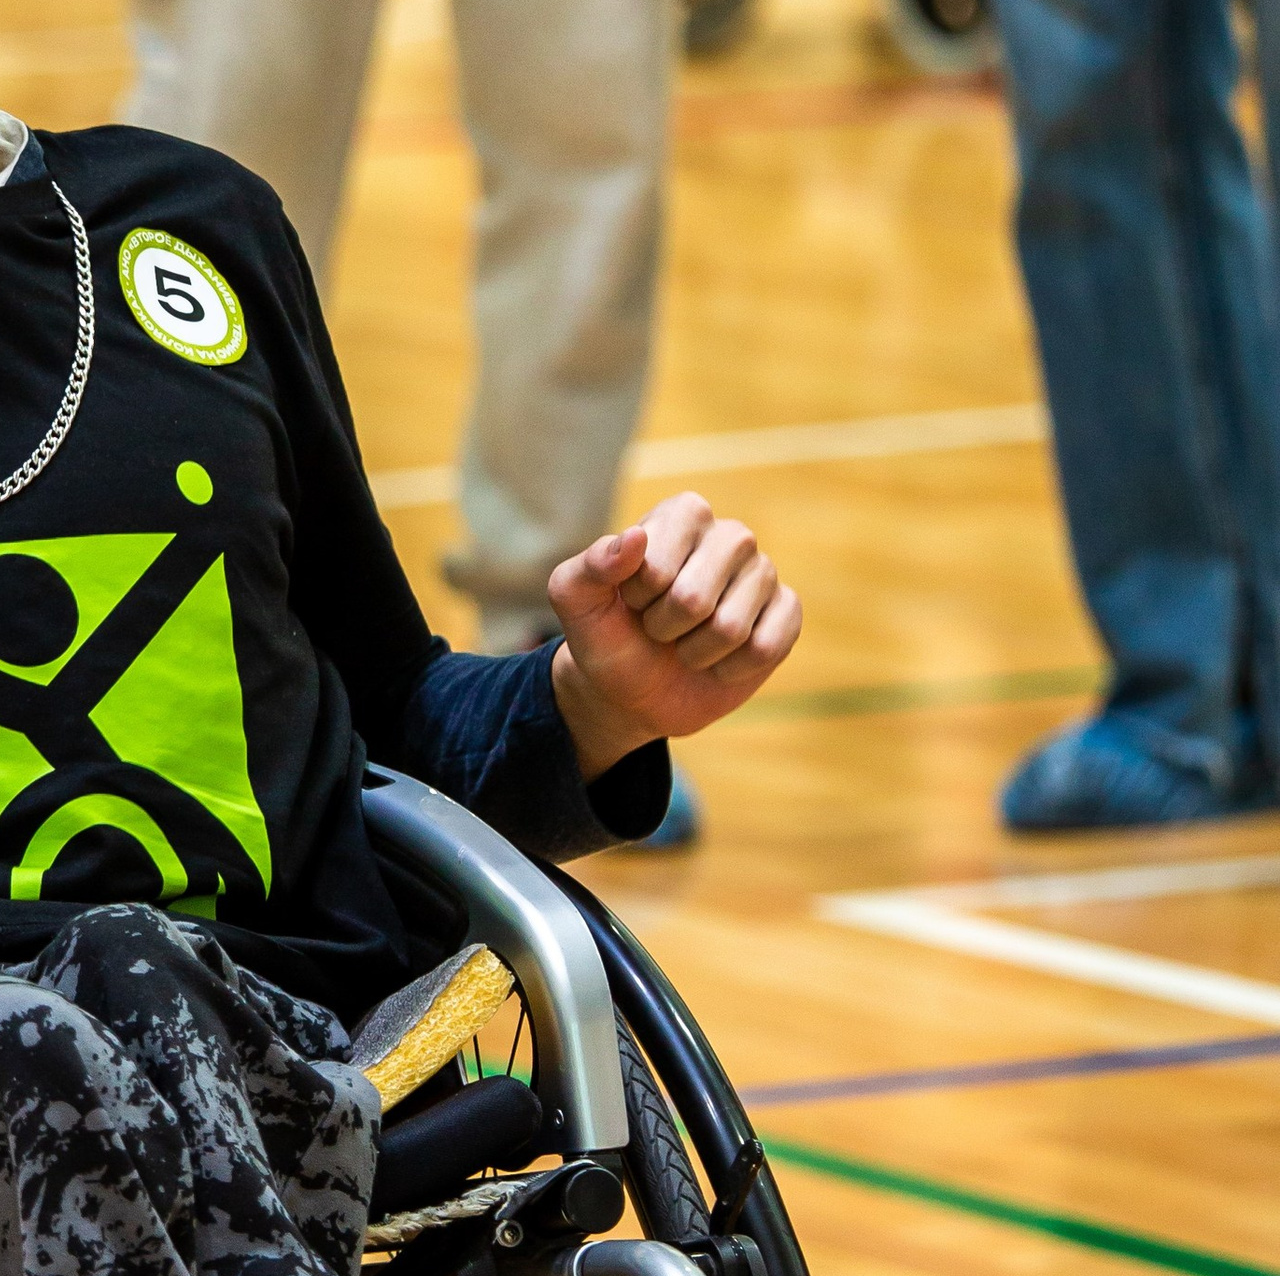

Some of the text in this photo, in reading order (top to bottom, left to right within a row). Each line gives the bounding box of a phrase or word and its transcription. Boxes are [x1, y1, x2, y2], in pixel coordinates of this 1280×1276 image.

[122, 248, 131, 280] АНО
[154, 265, 205, 322] 5
[195, 348, 220, 362] НА
[216, 323, 242, 359] ТЕННИС
